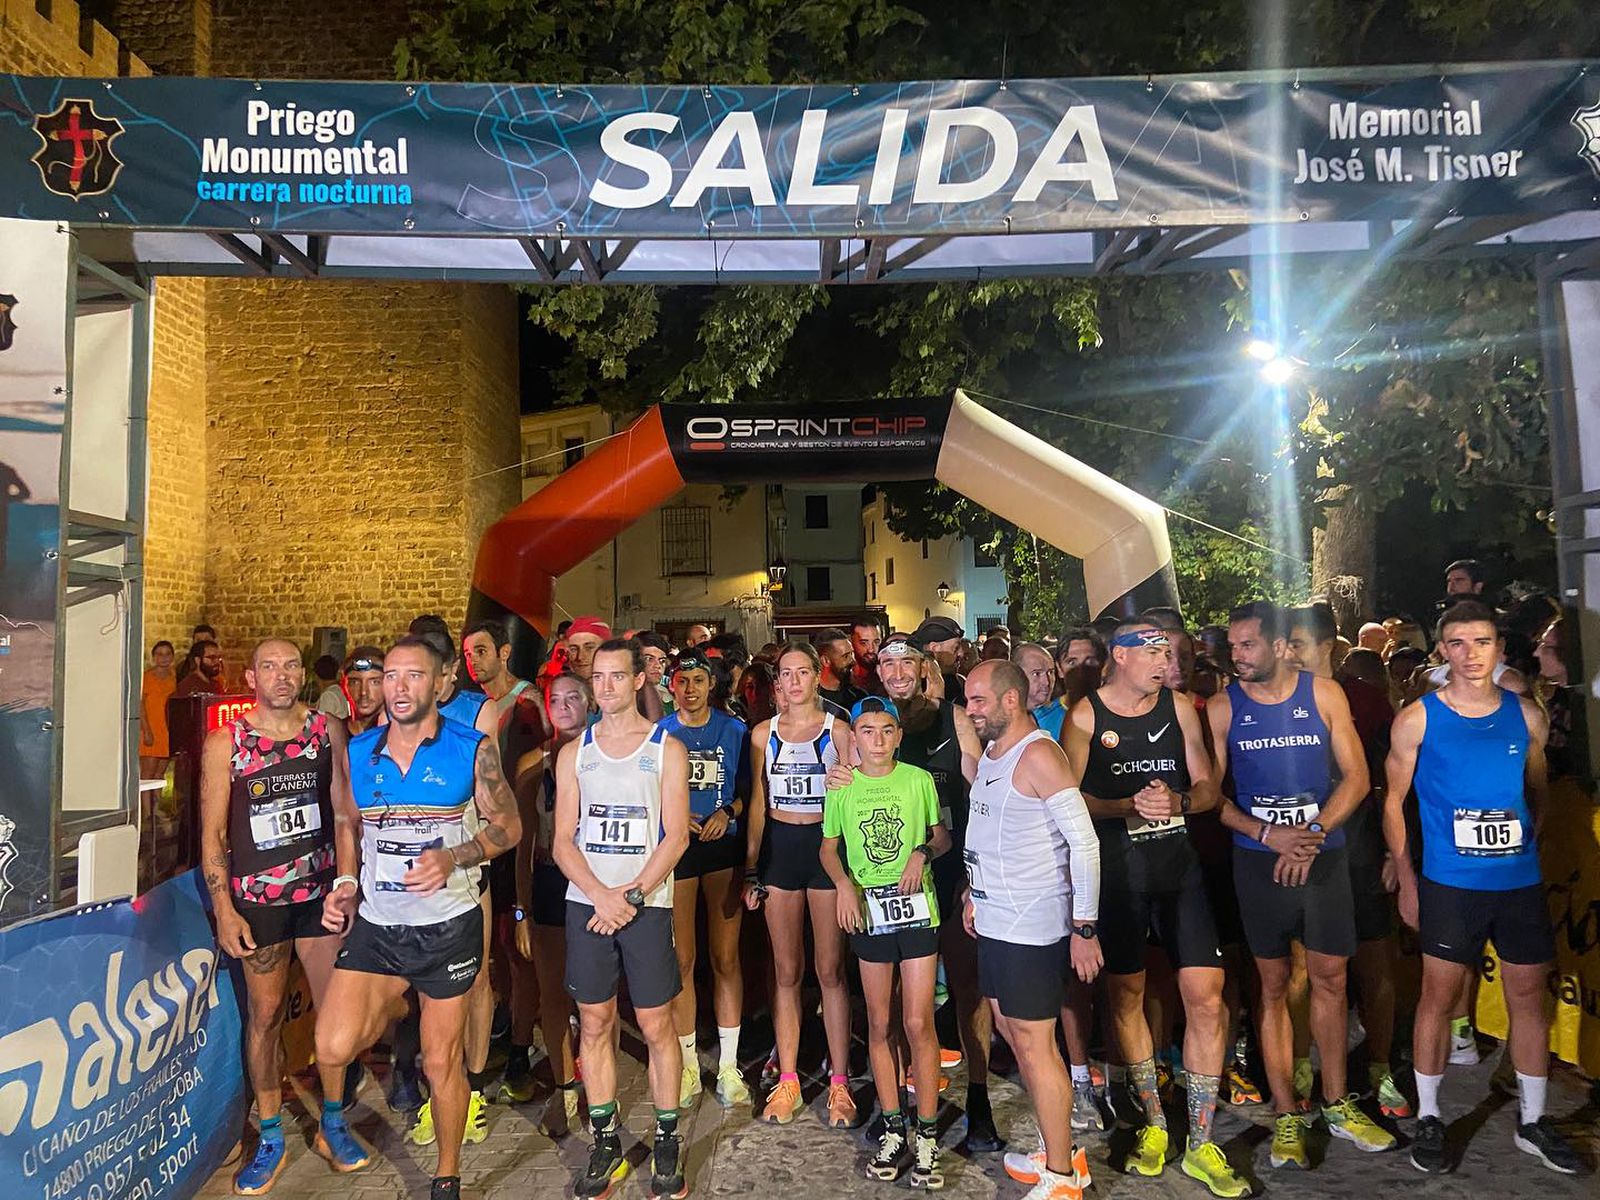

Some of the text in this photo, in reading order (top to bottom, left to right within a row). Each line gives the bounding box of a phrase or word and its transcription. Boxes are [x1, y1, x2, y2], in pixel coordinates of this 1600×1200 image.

[247, 99, 355, 143] Priego
[1328, 100, 1482, 140] Memorial
[201, 137, 408, 175] Monumental
[588, 105, 1119, 209] SALIDA
[1294, 145, 1524, 184] José M. Tisner
[197, 179, 412, 206] carrera nocturna
[730, 441, 789, 449] CRONOMETRAJE
[879, 439, 926, 447] DEPORTIVOS
[1238, 734, 1321, 751] TROTASIERRA
[270, 773, 306, 784] TIERRAS
[271, 780, 318, 792] CANENA
[784, 776, 812, 795] 151
[268, 809, 307, 836] 184
[1267, 808, 1306, 826] 254
[599, 820, 630, 843] 141
[1473, 823, 1511, 845] 105
[880, 897, 915, 922] 165
[168, 1104, 191, 1139] 34
[84, 1122, 139, 1175] PRIEGO
